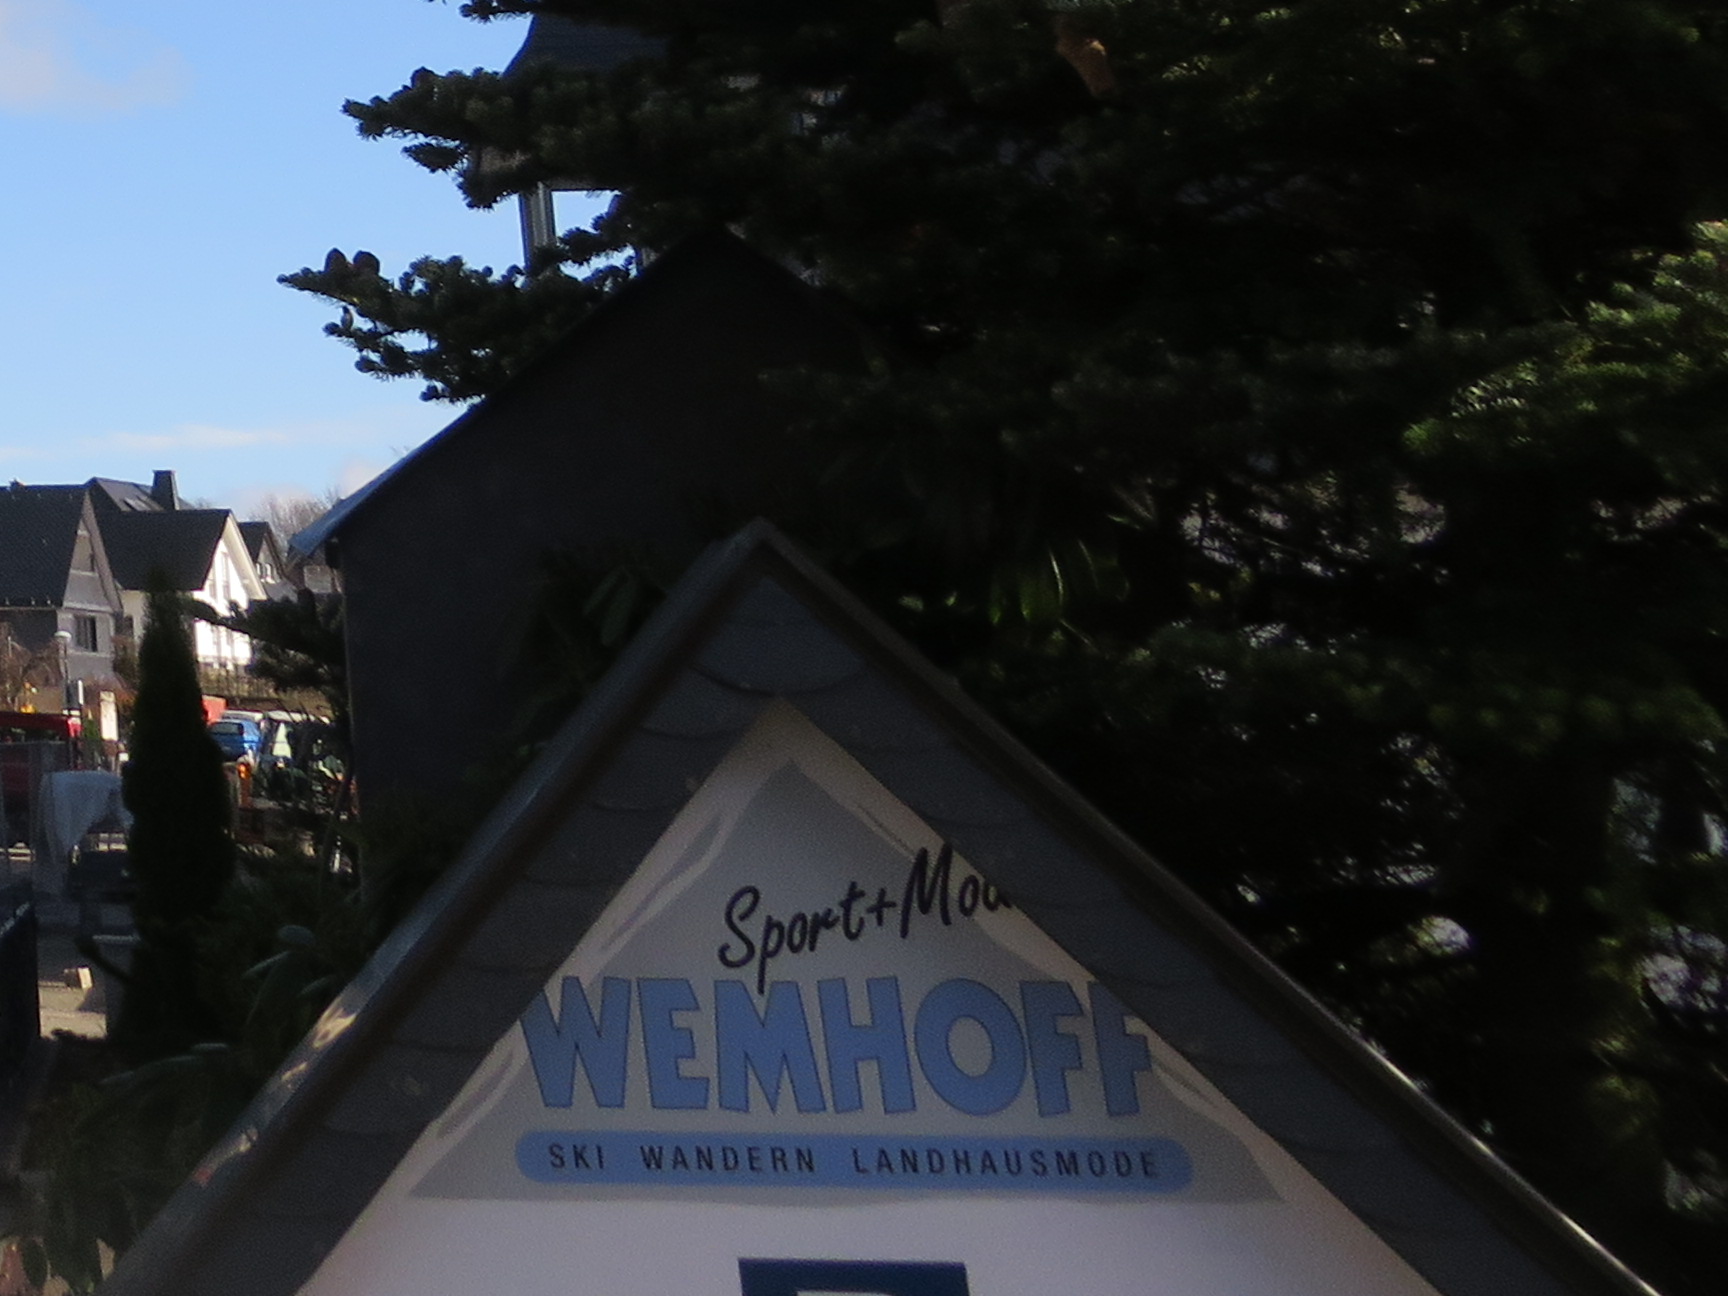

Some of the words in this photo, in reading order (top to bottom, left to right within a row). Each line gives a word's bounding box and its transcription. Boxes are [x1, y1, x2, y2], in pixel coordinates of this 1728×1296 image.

[519, 975, 1152, 1118] WEMHOFF
[548, 1143, 606, 1170] SKI
[640, 1145, 816, 1174] WANDERN
[853, 1148, 1160, 1179] LANDHAUSMODE
